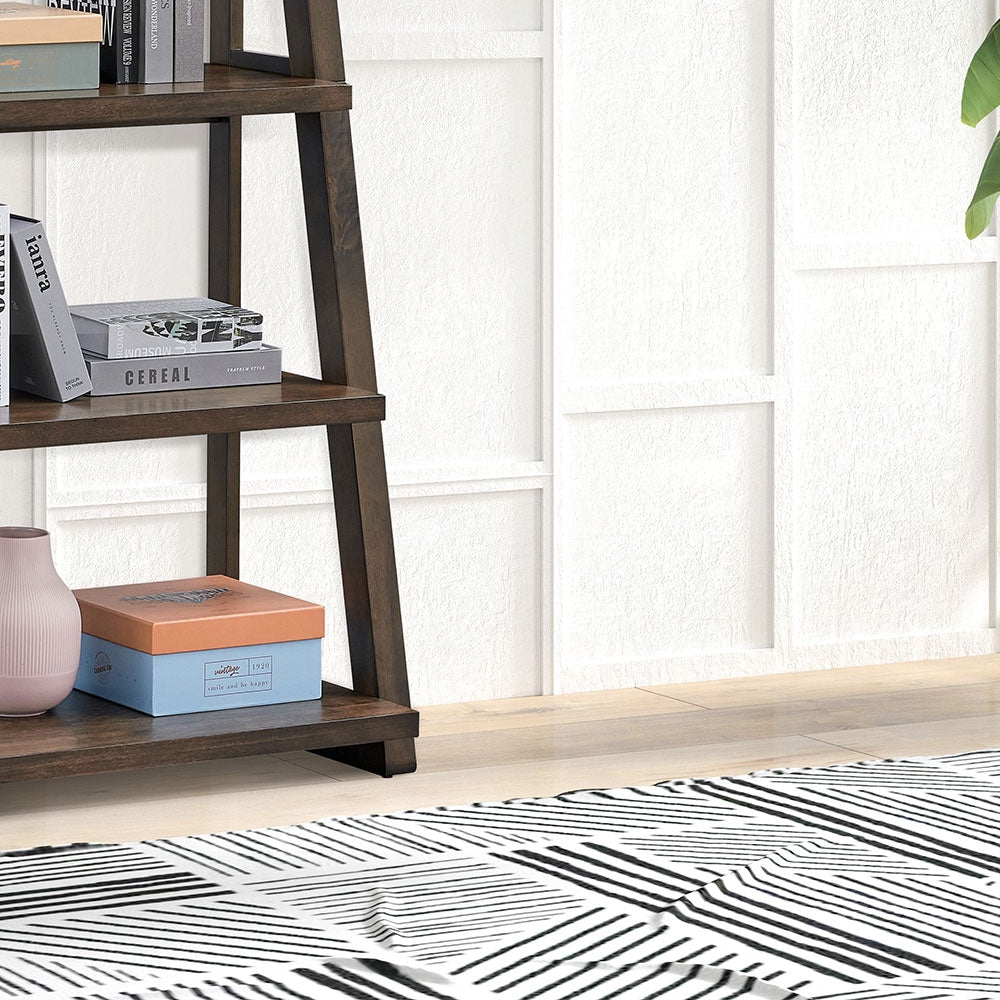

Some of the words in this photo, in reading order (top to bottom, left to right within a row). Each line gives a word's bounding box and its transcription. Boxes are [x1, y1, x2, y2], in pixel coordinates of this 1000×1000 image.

[25, 234, 52, 293] ianra
[125, 346, 172, 358] MUSEUM
[124, 366, 191, 386] CEREAL
[252, 662, 270, 671] 1920
[250, 680, 269, 688] happy
